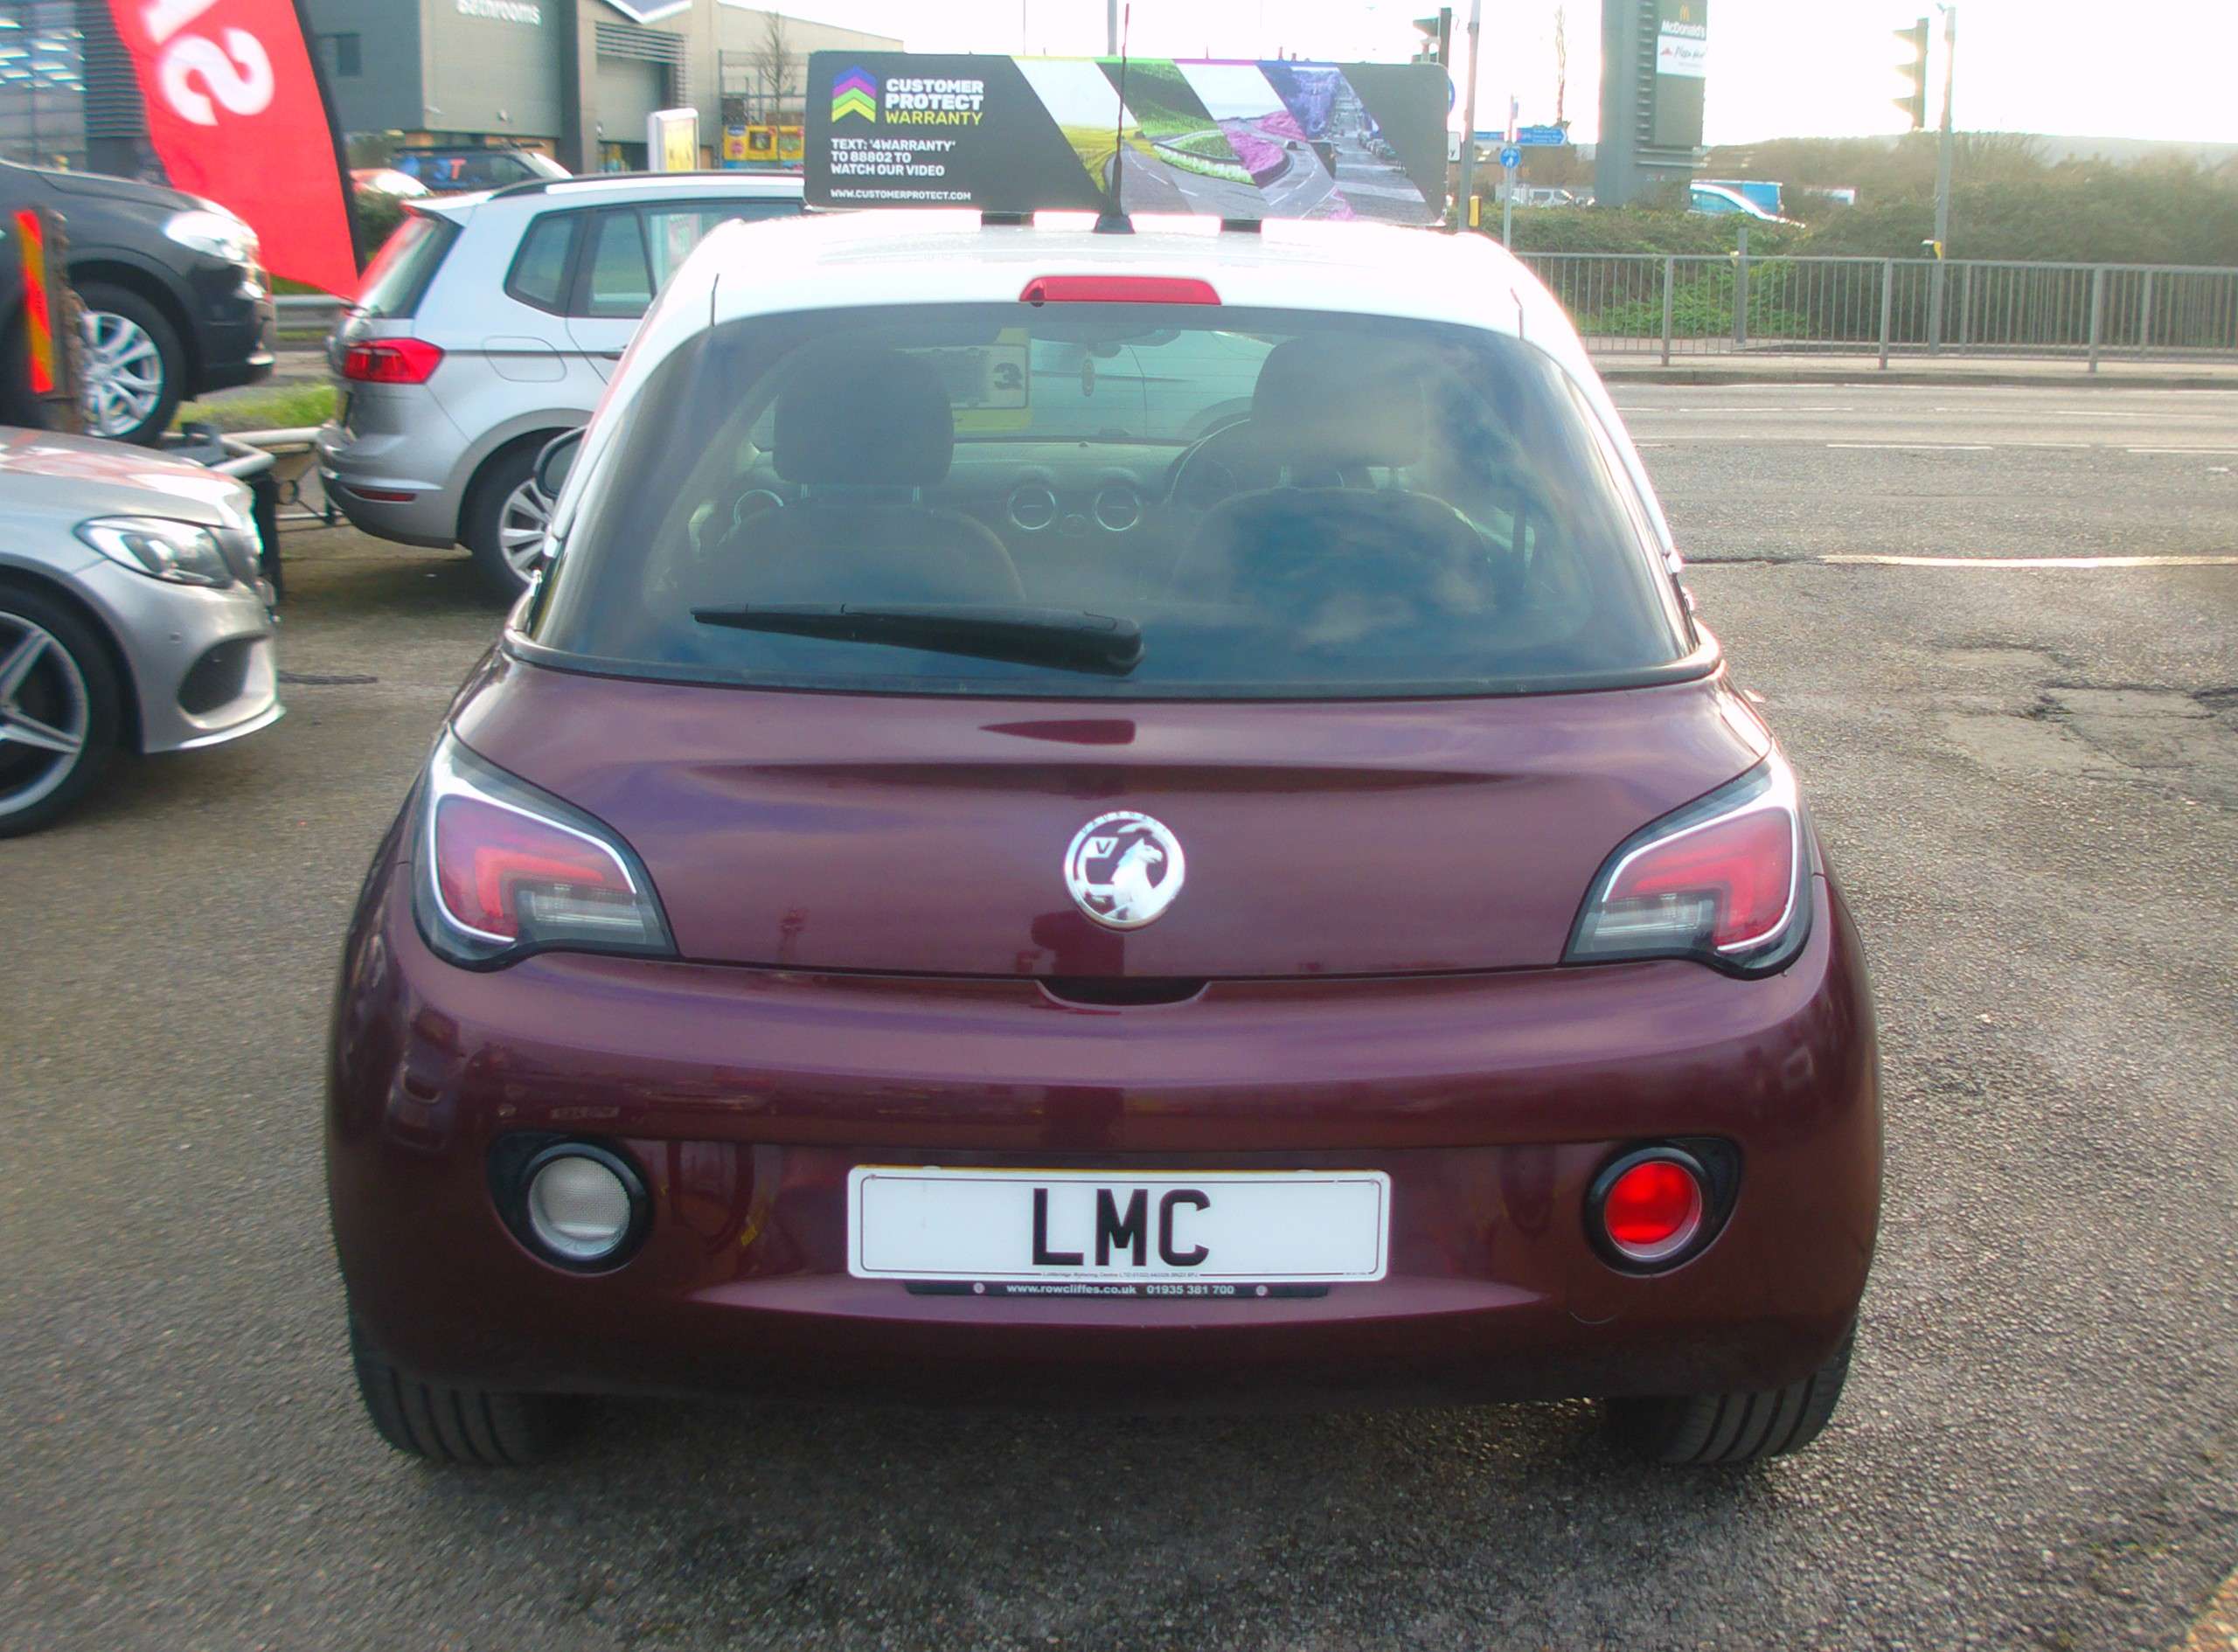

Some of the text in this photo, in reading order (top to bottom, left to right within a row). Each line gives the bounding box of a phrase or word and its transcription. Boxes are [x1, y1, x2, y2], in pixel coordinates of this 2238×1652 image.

[886, 78, 984, 94] CUSTOMER
[885, 93, 983, 110] PROTECT
[886, 110, 983, 125] WARRANTY
[831, 138, 867, 149] TEXT:
[831, 150, 912, 163] TO 88802 TO
[831, 163, 945, 177] WATCH OUR VIDEO
[831, 189, 971, 200] WWW.CUSTOMERPROTECT.COM
[1032, 1188, 1211, 1267] LMC
[1006, 1285, 1235, 1295] www.rowcliffes.co.uk 01935 381 700
